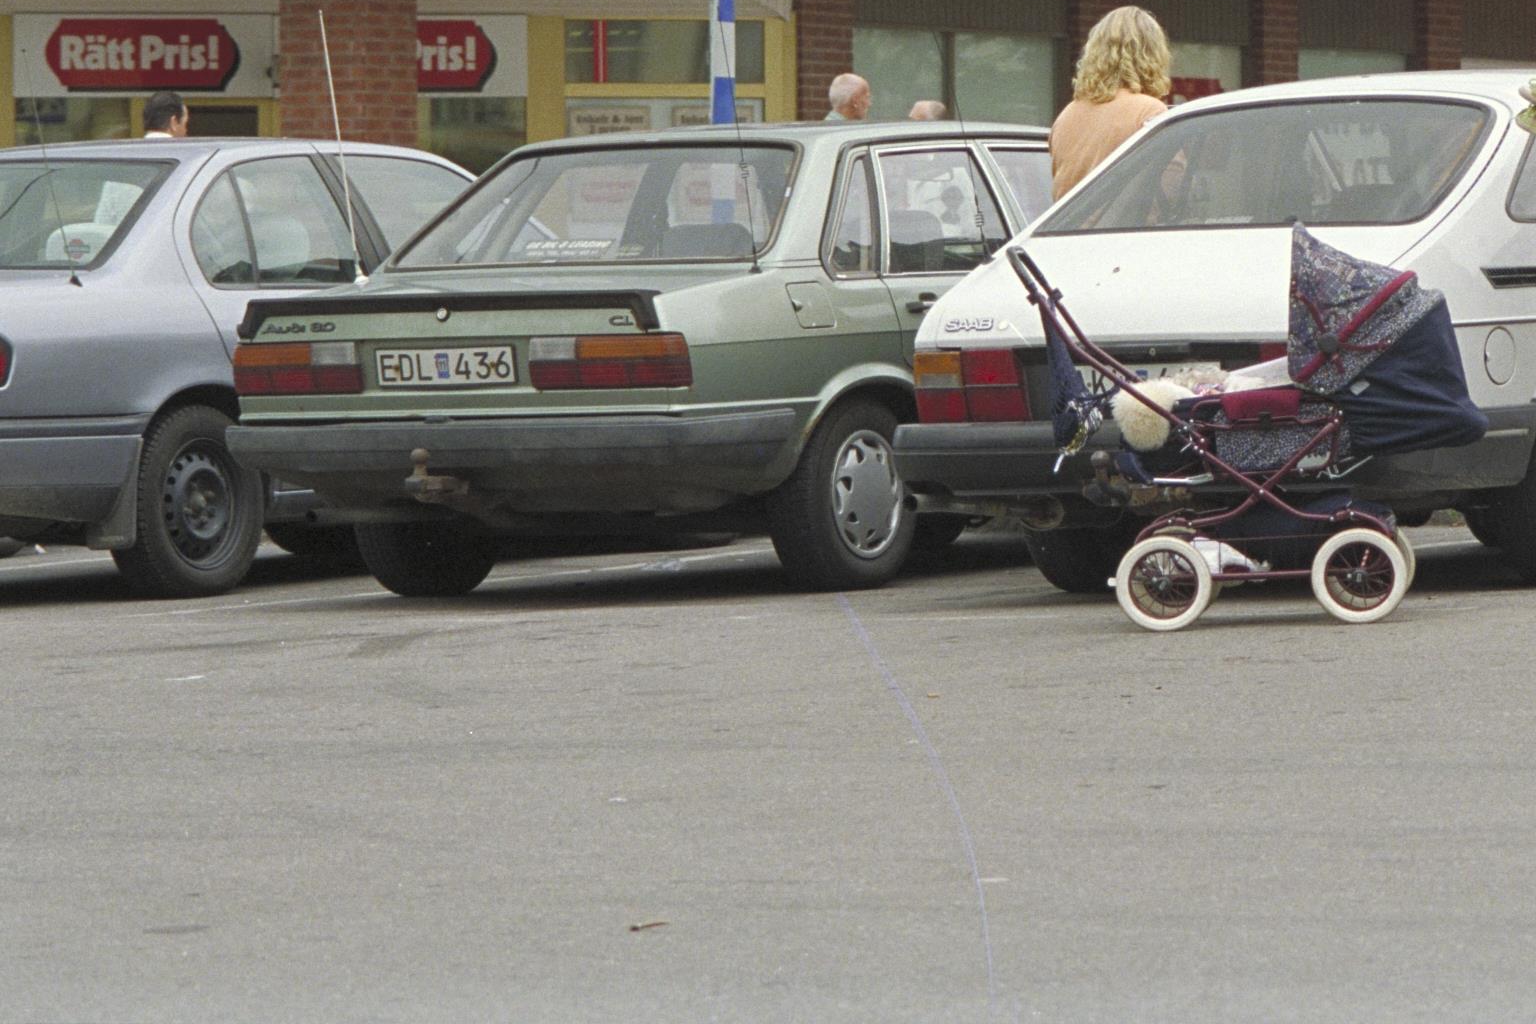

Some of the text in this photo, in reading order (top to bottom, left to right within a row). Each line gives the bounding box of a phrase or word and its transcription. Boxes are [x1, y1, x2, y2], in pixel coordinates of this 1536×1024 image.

[59, 34, 219, 71] Rätt Pris!
[417, 35, 477, 71] ris!
[262, 322, 337, 334] Audi 80
[944, 317, 994, 333] SAAB
[379, 352, 434, 383] EDL
[455, 350, 511, 380] 436
